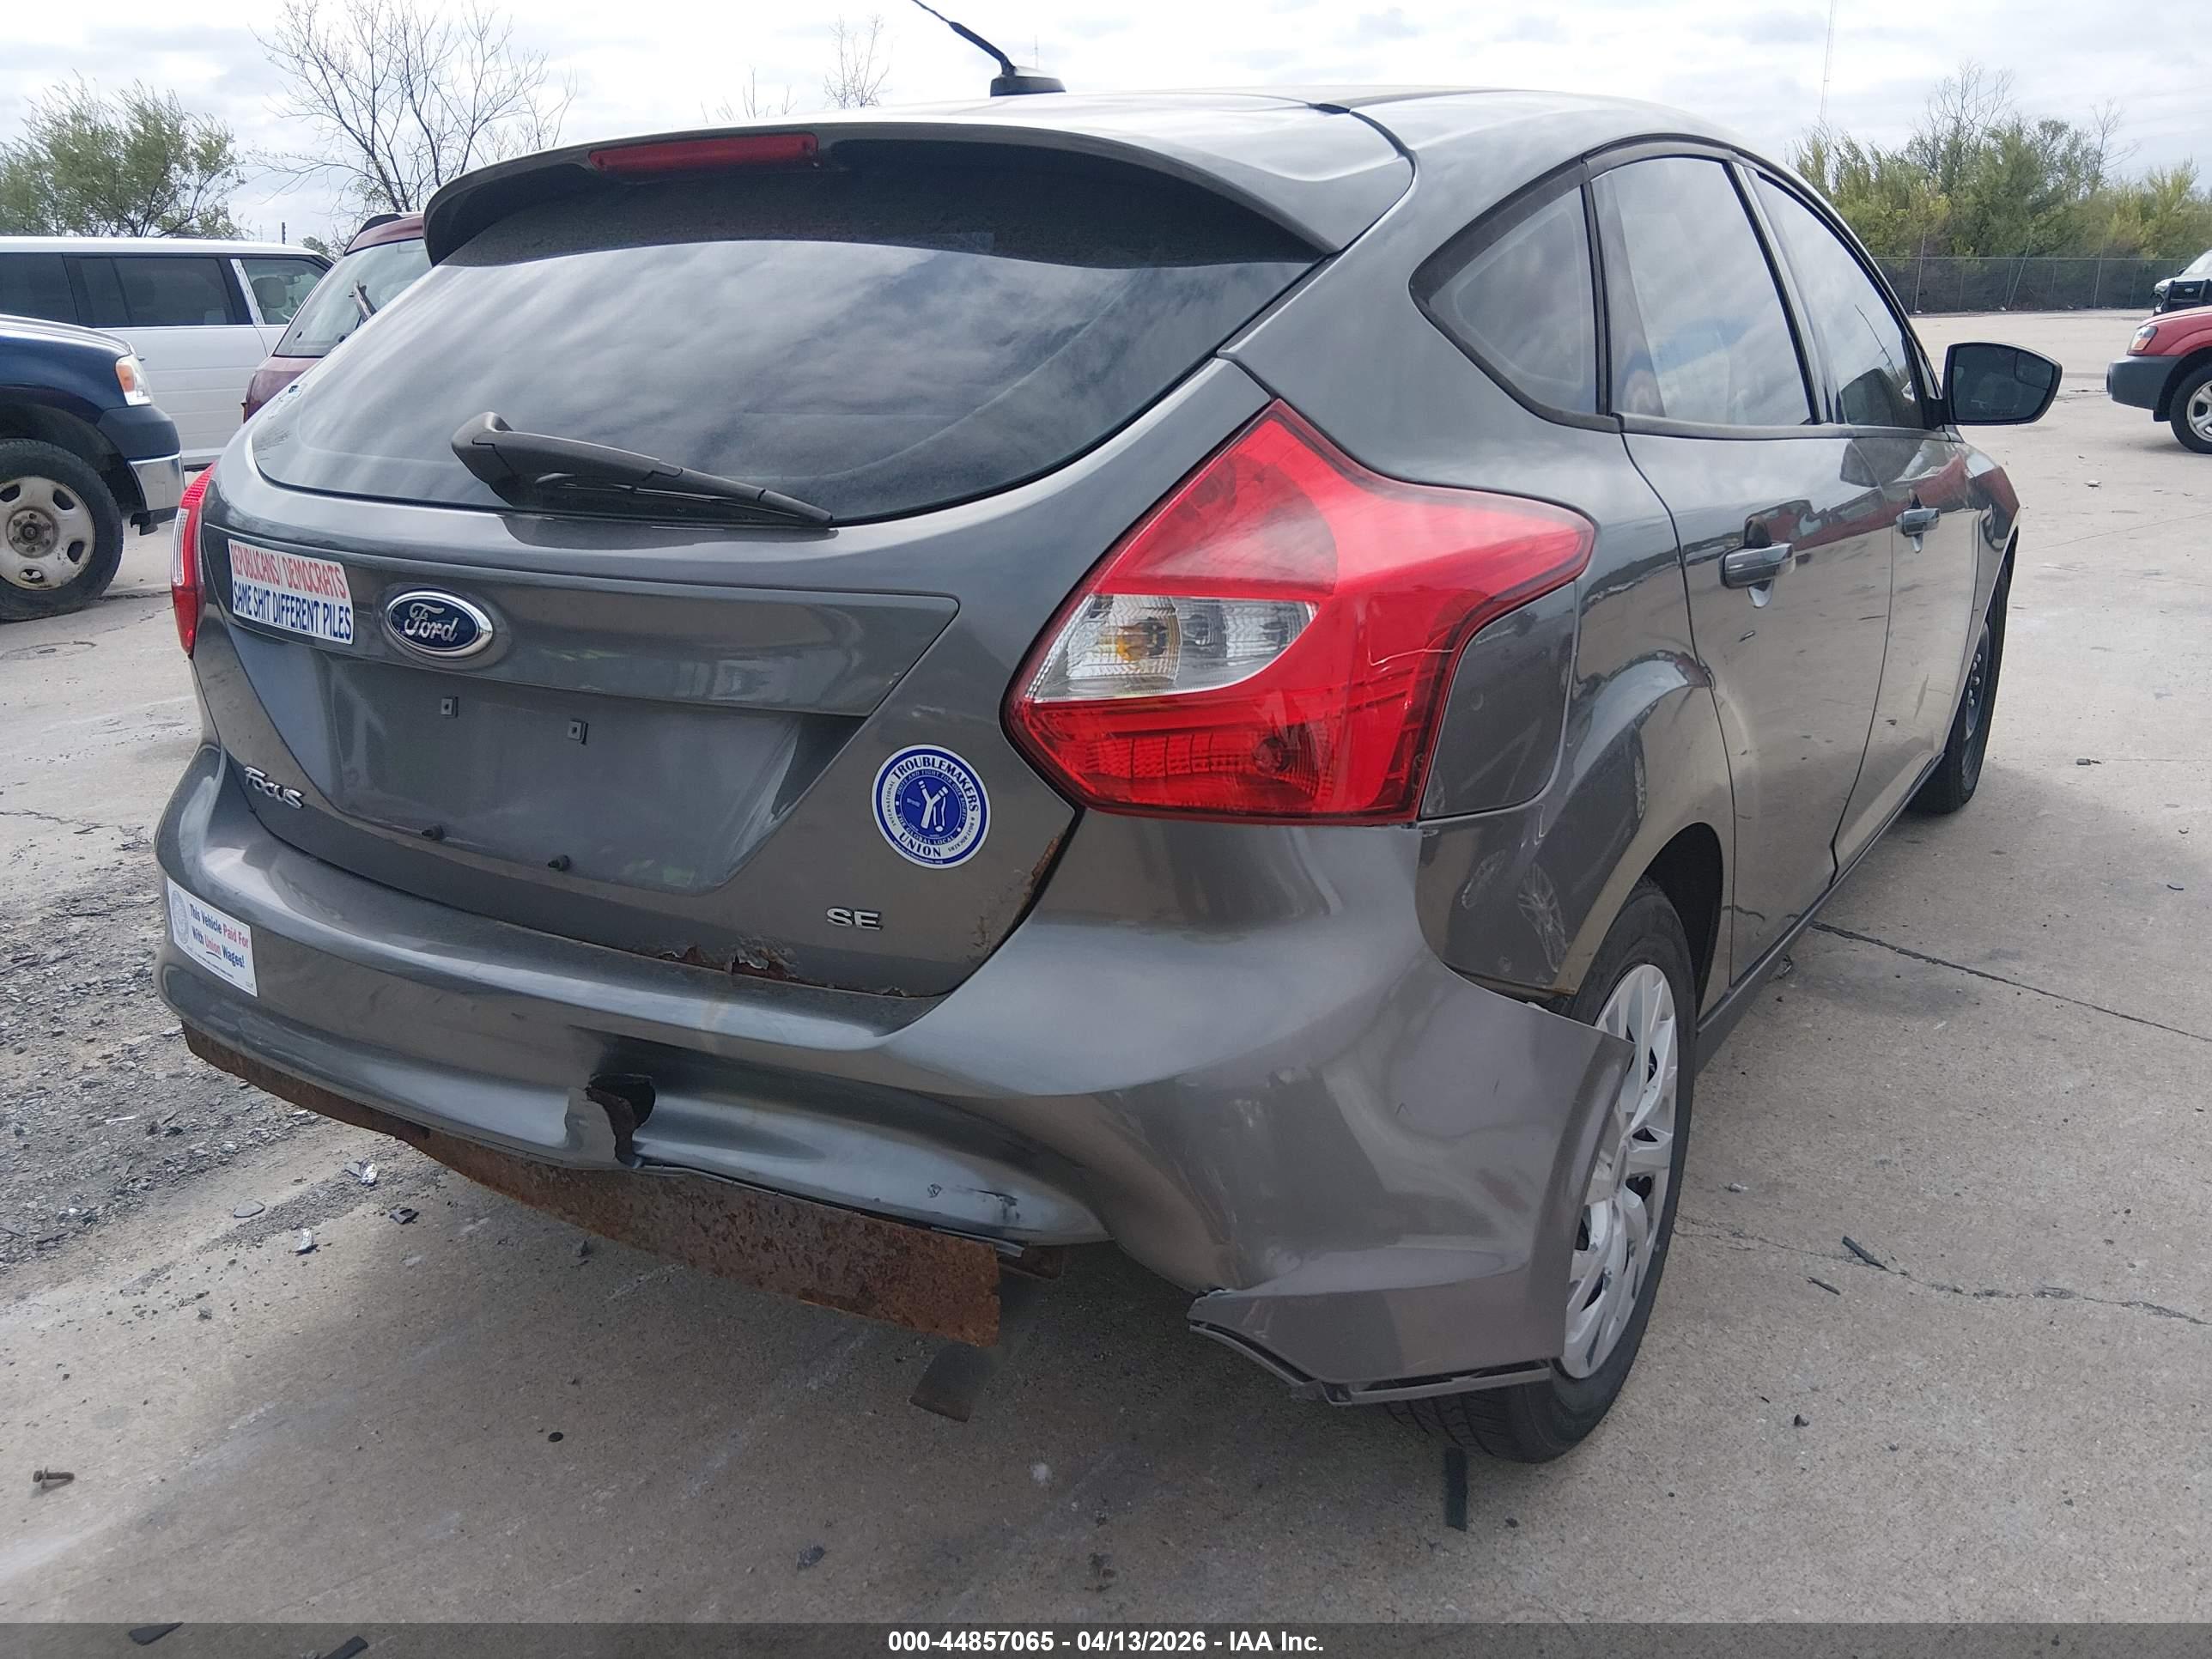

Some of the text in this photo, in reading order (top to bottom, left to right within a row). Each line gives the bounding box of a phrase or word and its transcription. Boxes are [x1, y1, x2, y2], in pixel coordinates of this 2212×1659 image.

[282, 556, 347, 599] DEMOCRATS
[234, 580, 351, 640] SAME SHIT DIFFERENT PILES
[404, 603, 459, 641] Ford
[891, 757, 979, 812] TROUBLEMAKERS
[908, 771, 920, 780] AND
[941, 774, 952, 784] FOR
[898, 832, 941, 857] UNION
[906, 827, 931, 845] GLOBAL
[934, 835, 954, 845] LOCAL
[190, 904, 248, 948] This Vehicle Paid For
[827, 908, 880, 930] SE
[205, 936, 221, 953] Union
[222, 945, 245, 969] Wages!
